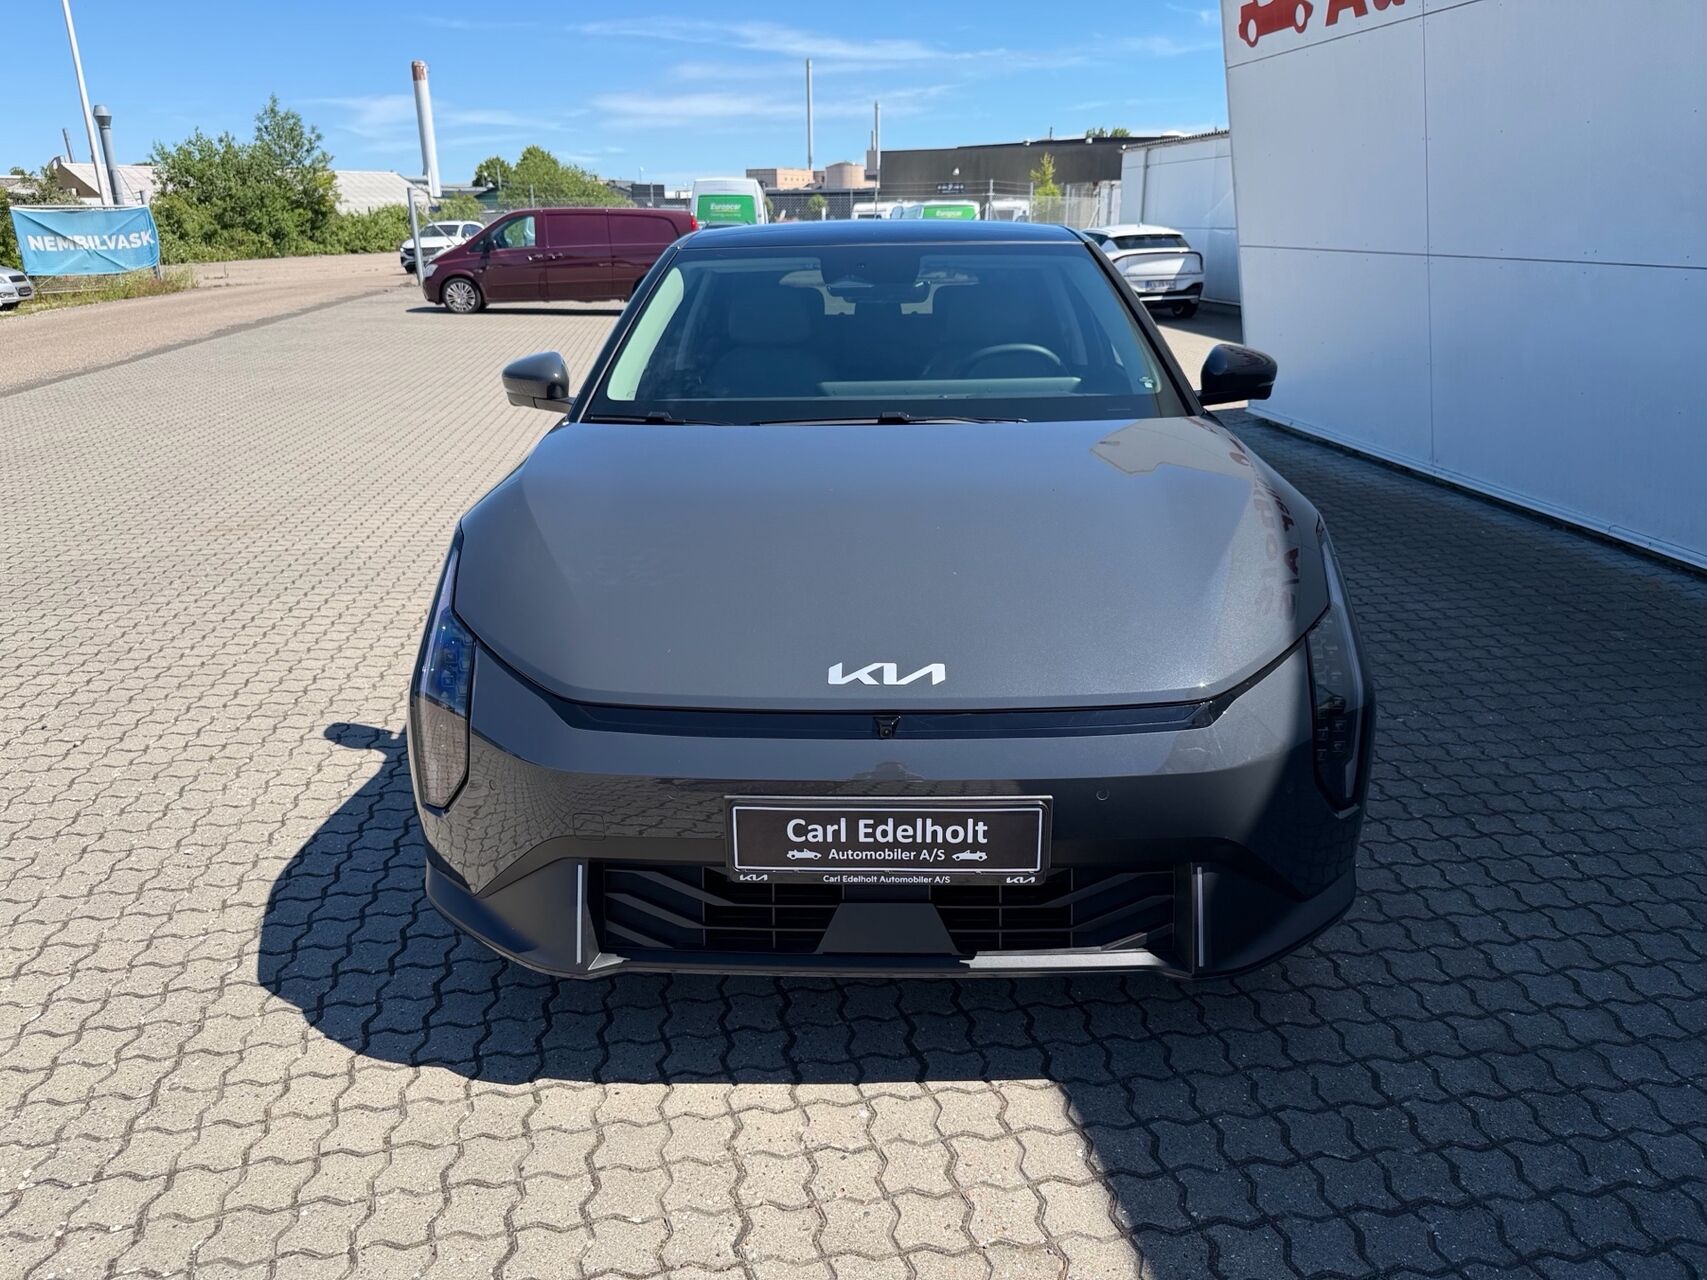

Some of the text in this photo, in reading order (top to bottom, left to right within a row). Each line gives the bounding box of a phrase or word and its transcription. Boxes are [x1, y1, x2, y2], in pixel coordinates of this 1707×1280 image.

[27, 231, 154, 251] NEMBILVASK
[829, 662, 945, 685] KIA
[787, 818, 988, 843] Carl Edelholt
[828, 848, 945, 862] Automobiler A/S
[739, 874, 768, 882] KIA
[823, 875, 951, 885] Carl Edelholt Automobiler A/S
[1006, 876, 1036, 884] KIA
